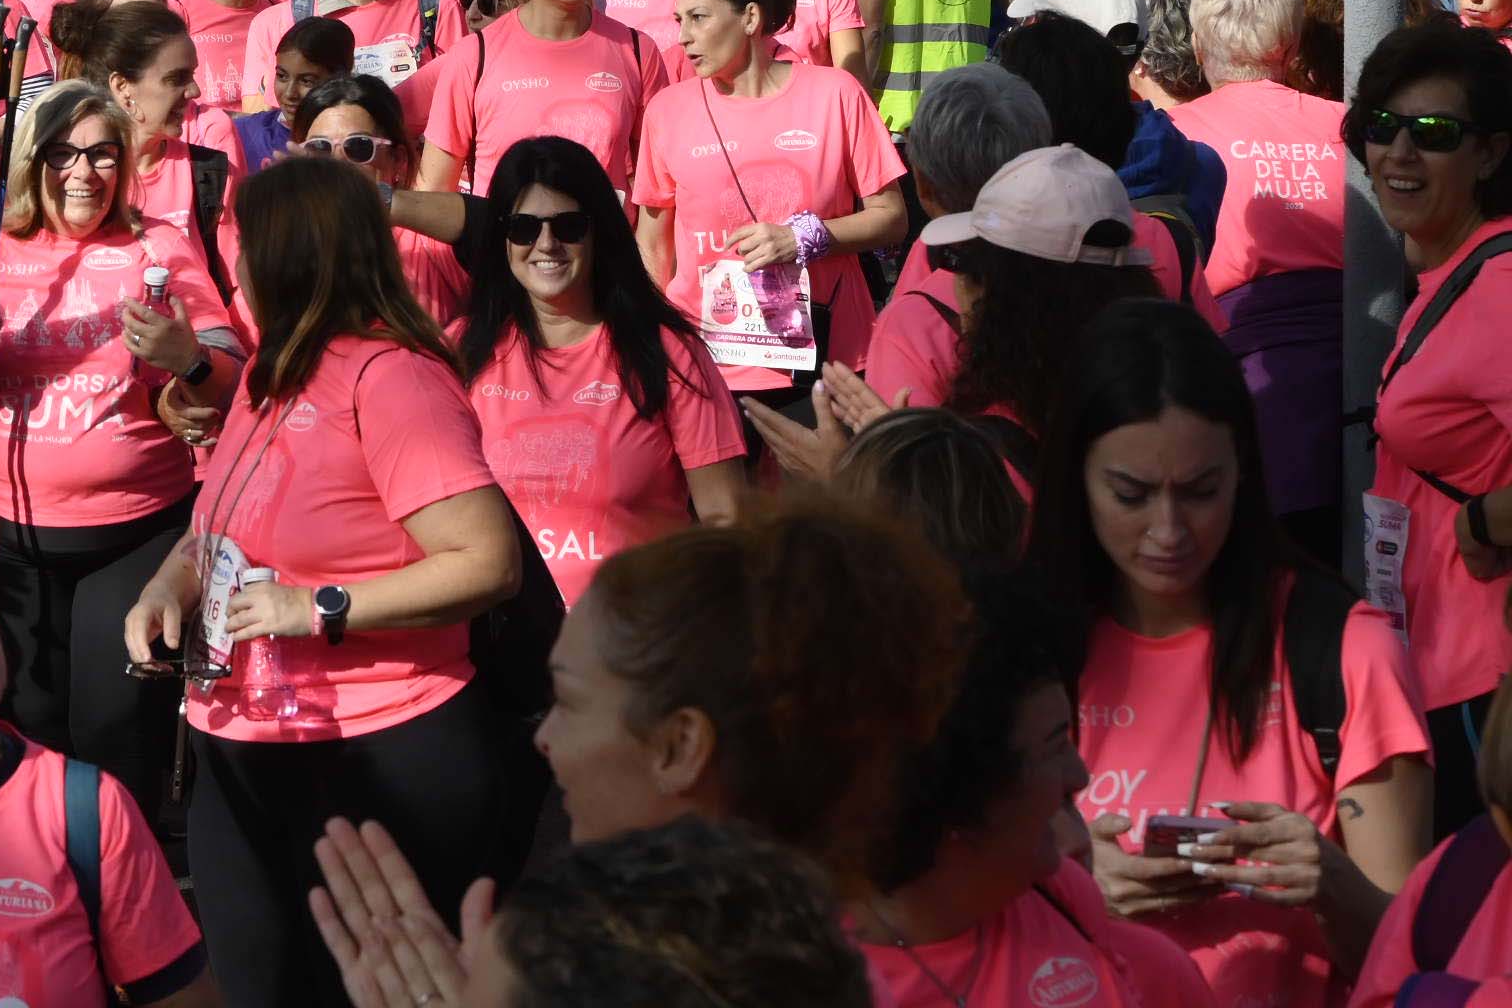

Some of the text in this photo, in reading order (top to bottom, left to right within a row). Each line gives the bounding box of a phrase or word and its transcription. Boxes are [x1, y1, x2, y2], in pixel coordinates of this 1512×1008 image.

[502, 77, 550, 92] OYSHO
[1230, 140, 1338, 161] CARRERA
[1255, 160, 1320, 180] DE LA
[1254, 179, 1328, 200] MUJER
[694, 229, 729, 255] TU
[538, 528, 604, 561] SAL
[1080, 769, 1148, 806] OY
